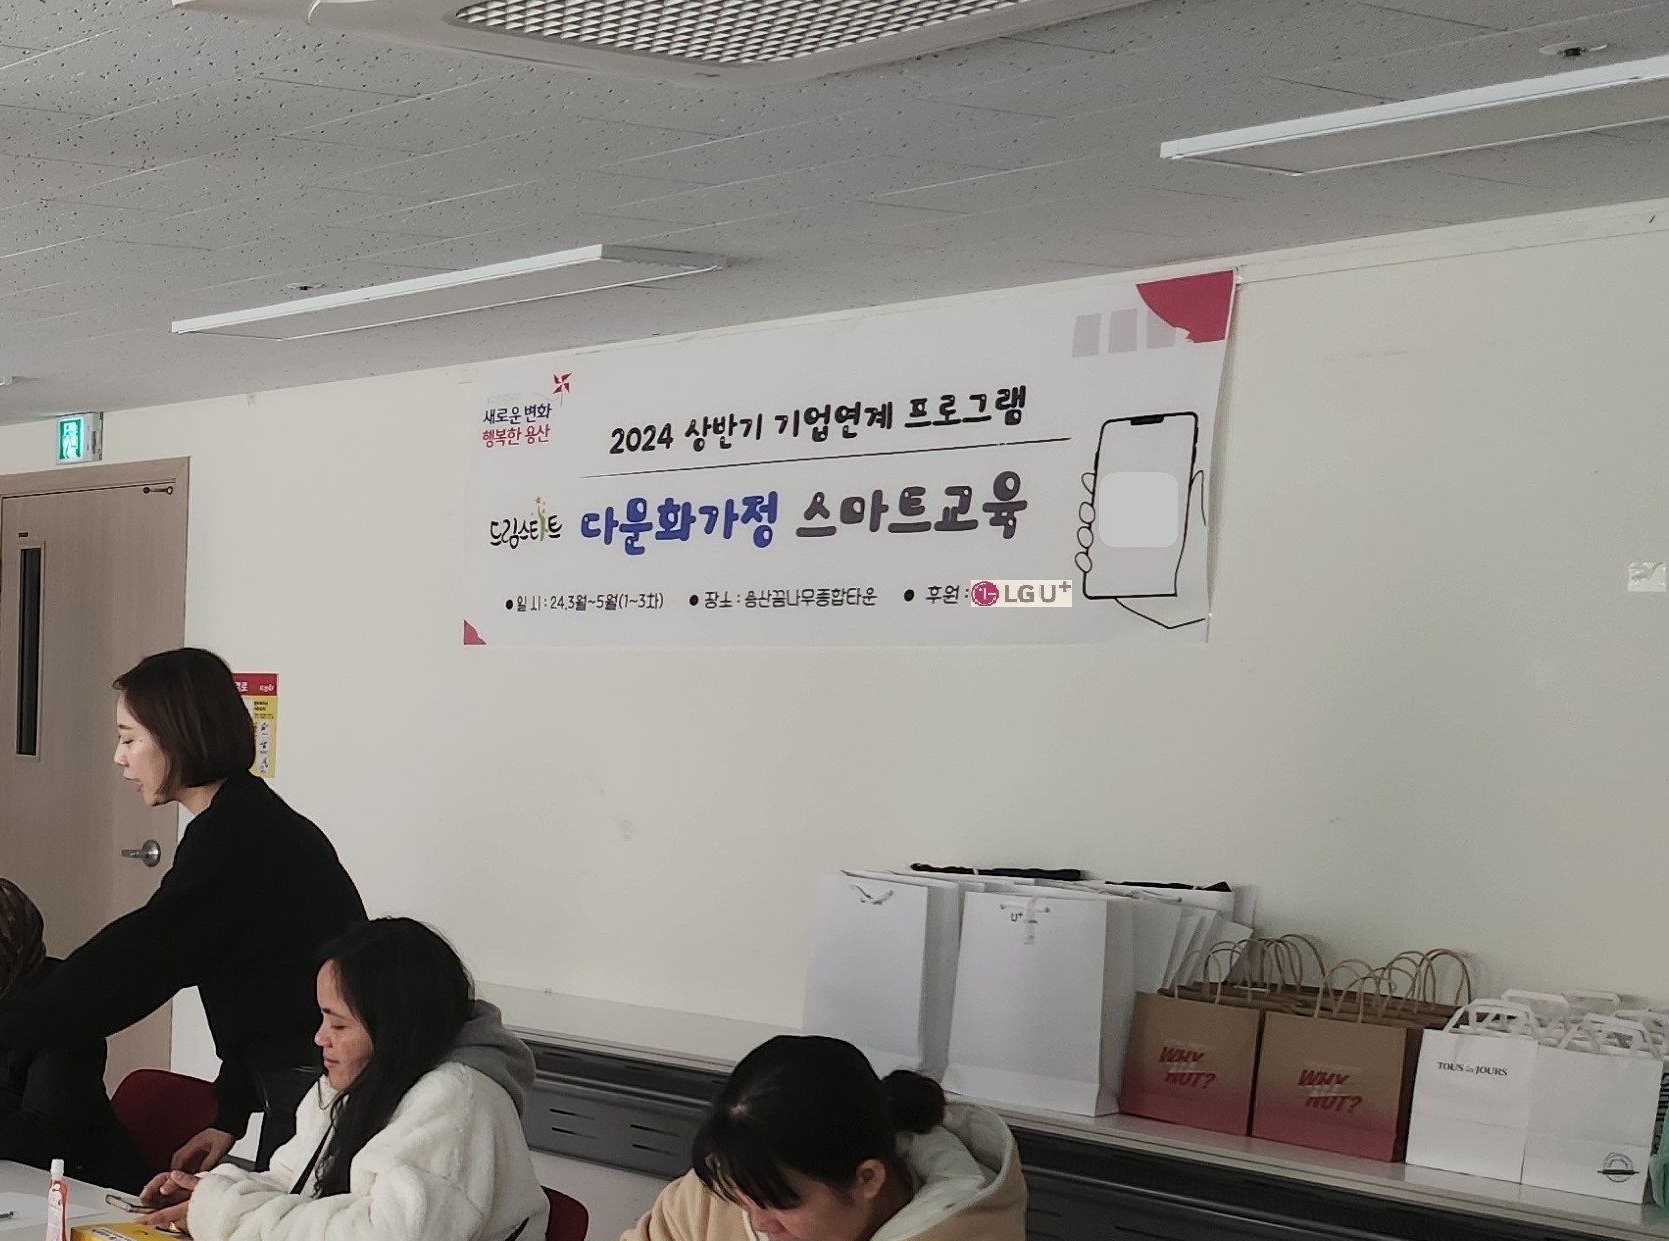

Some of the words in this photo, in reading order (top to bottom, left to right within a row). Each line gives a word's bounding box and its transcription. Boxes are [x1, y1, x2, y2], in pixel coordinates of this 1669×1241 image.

[483, 406, 522, 424] 새로운
[524, 403, 552, 423] 변화
[610, 423, 674, 454] 2024
[685, 413, 763, 452] 상반기
[775, 401, 893, 442] 기업연계
[904, 385, 1027, 427] 프로그램
[482, 426, 522, 448] 행복한
[524, 423, 551, 444] 용산
[581, 491, 778, 555] 다문화가정
[796, 471, 1028, 539] 스마트교육
[490, 506, 563, 549] 드림스타트
[744, 587, 878, 608] 용산꿈나무종합타운
[1436, 1061, 1464, 1072] TOUS
[1475, 1065, 1508, 1076] JOURS
